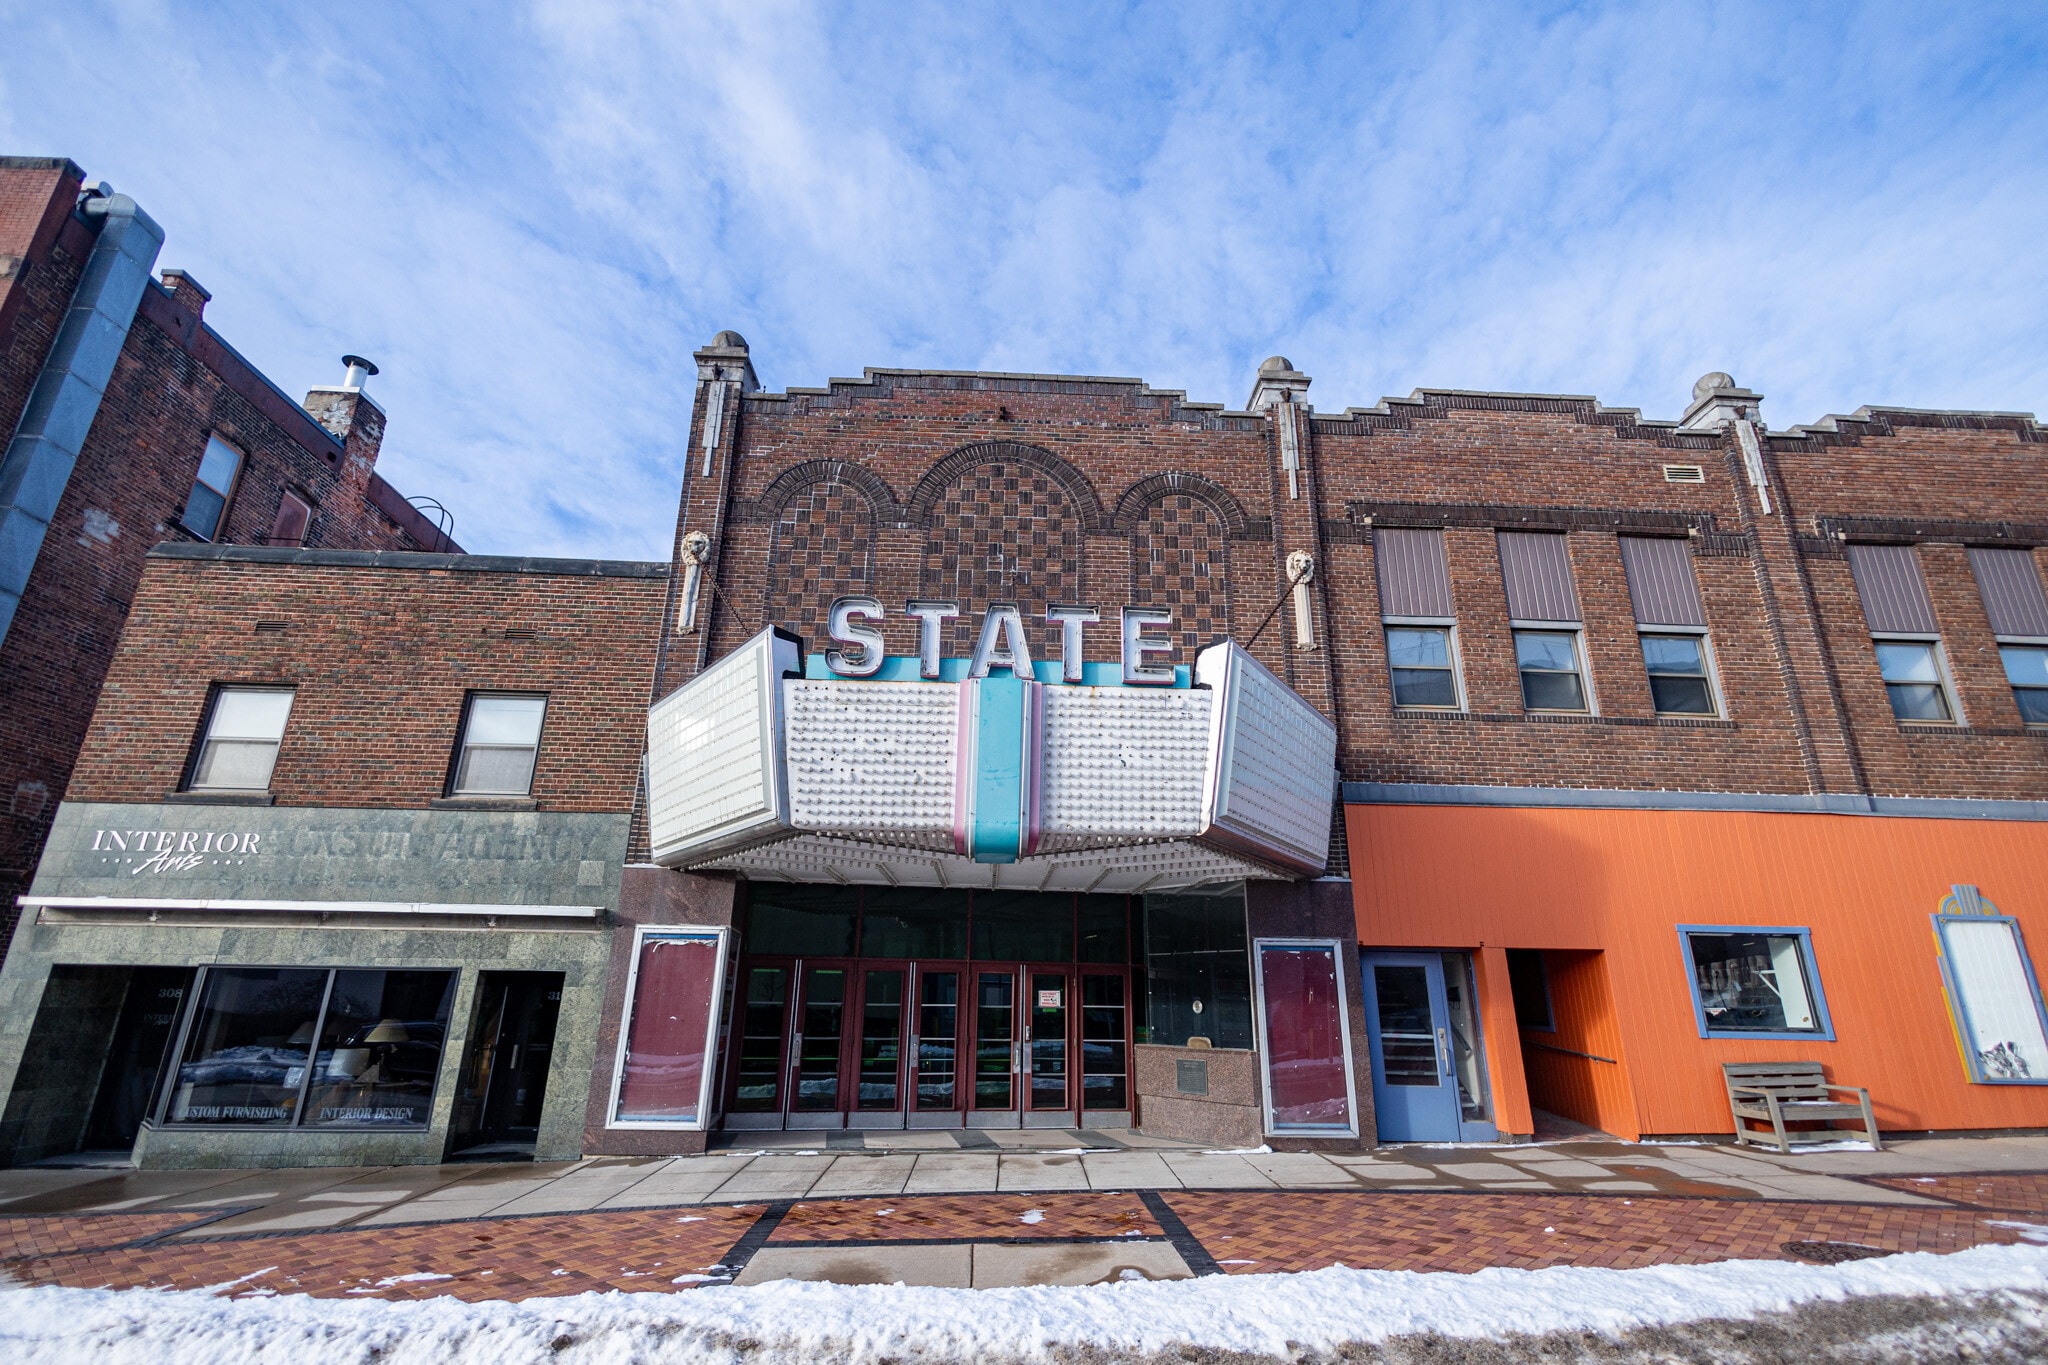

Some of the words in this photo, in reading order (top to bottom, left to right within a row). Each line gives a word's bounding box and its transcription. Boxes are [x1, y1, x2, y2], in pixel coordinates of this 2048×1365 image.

[827, 595, 1176, 684] STATE
[92, 830, 260, 853] INTERIOR
[132, 845, 203, 875] Arts
[159, 988, 183, 998] 308
[221, 1106, 288, 1119] FURNISHING
[320, 1107, 372, 1119] INTERIOR
[373, 1107, 414, 1119] DESIGN
